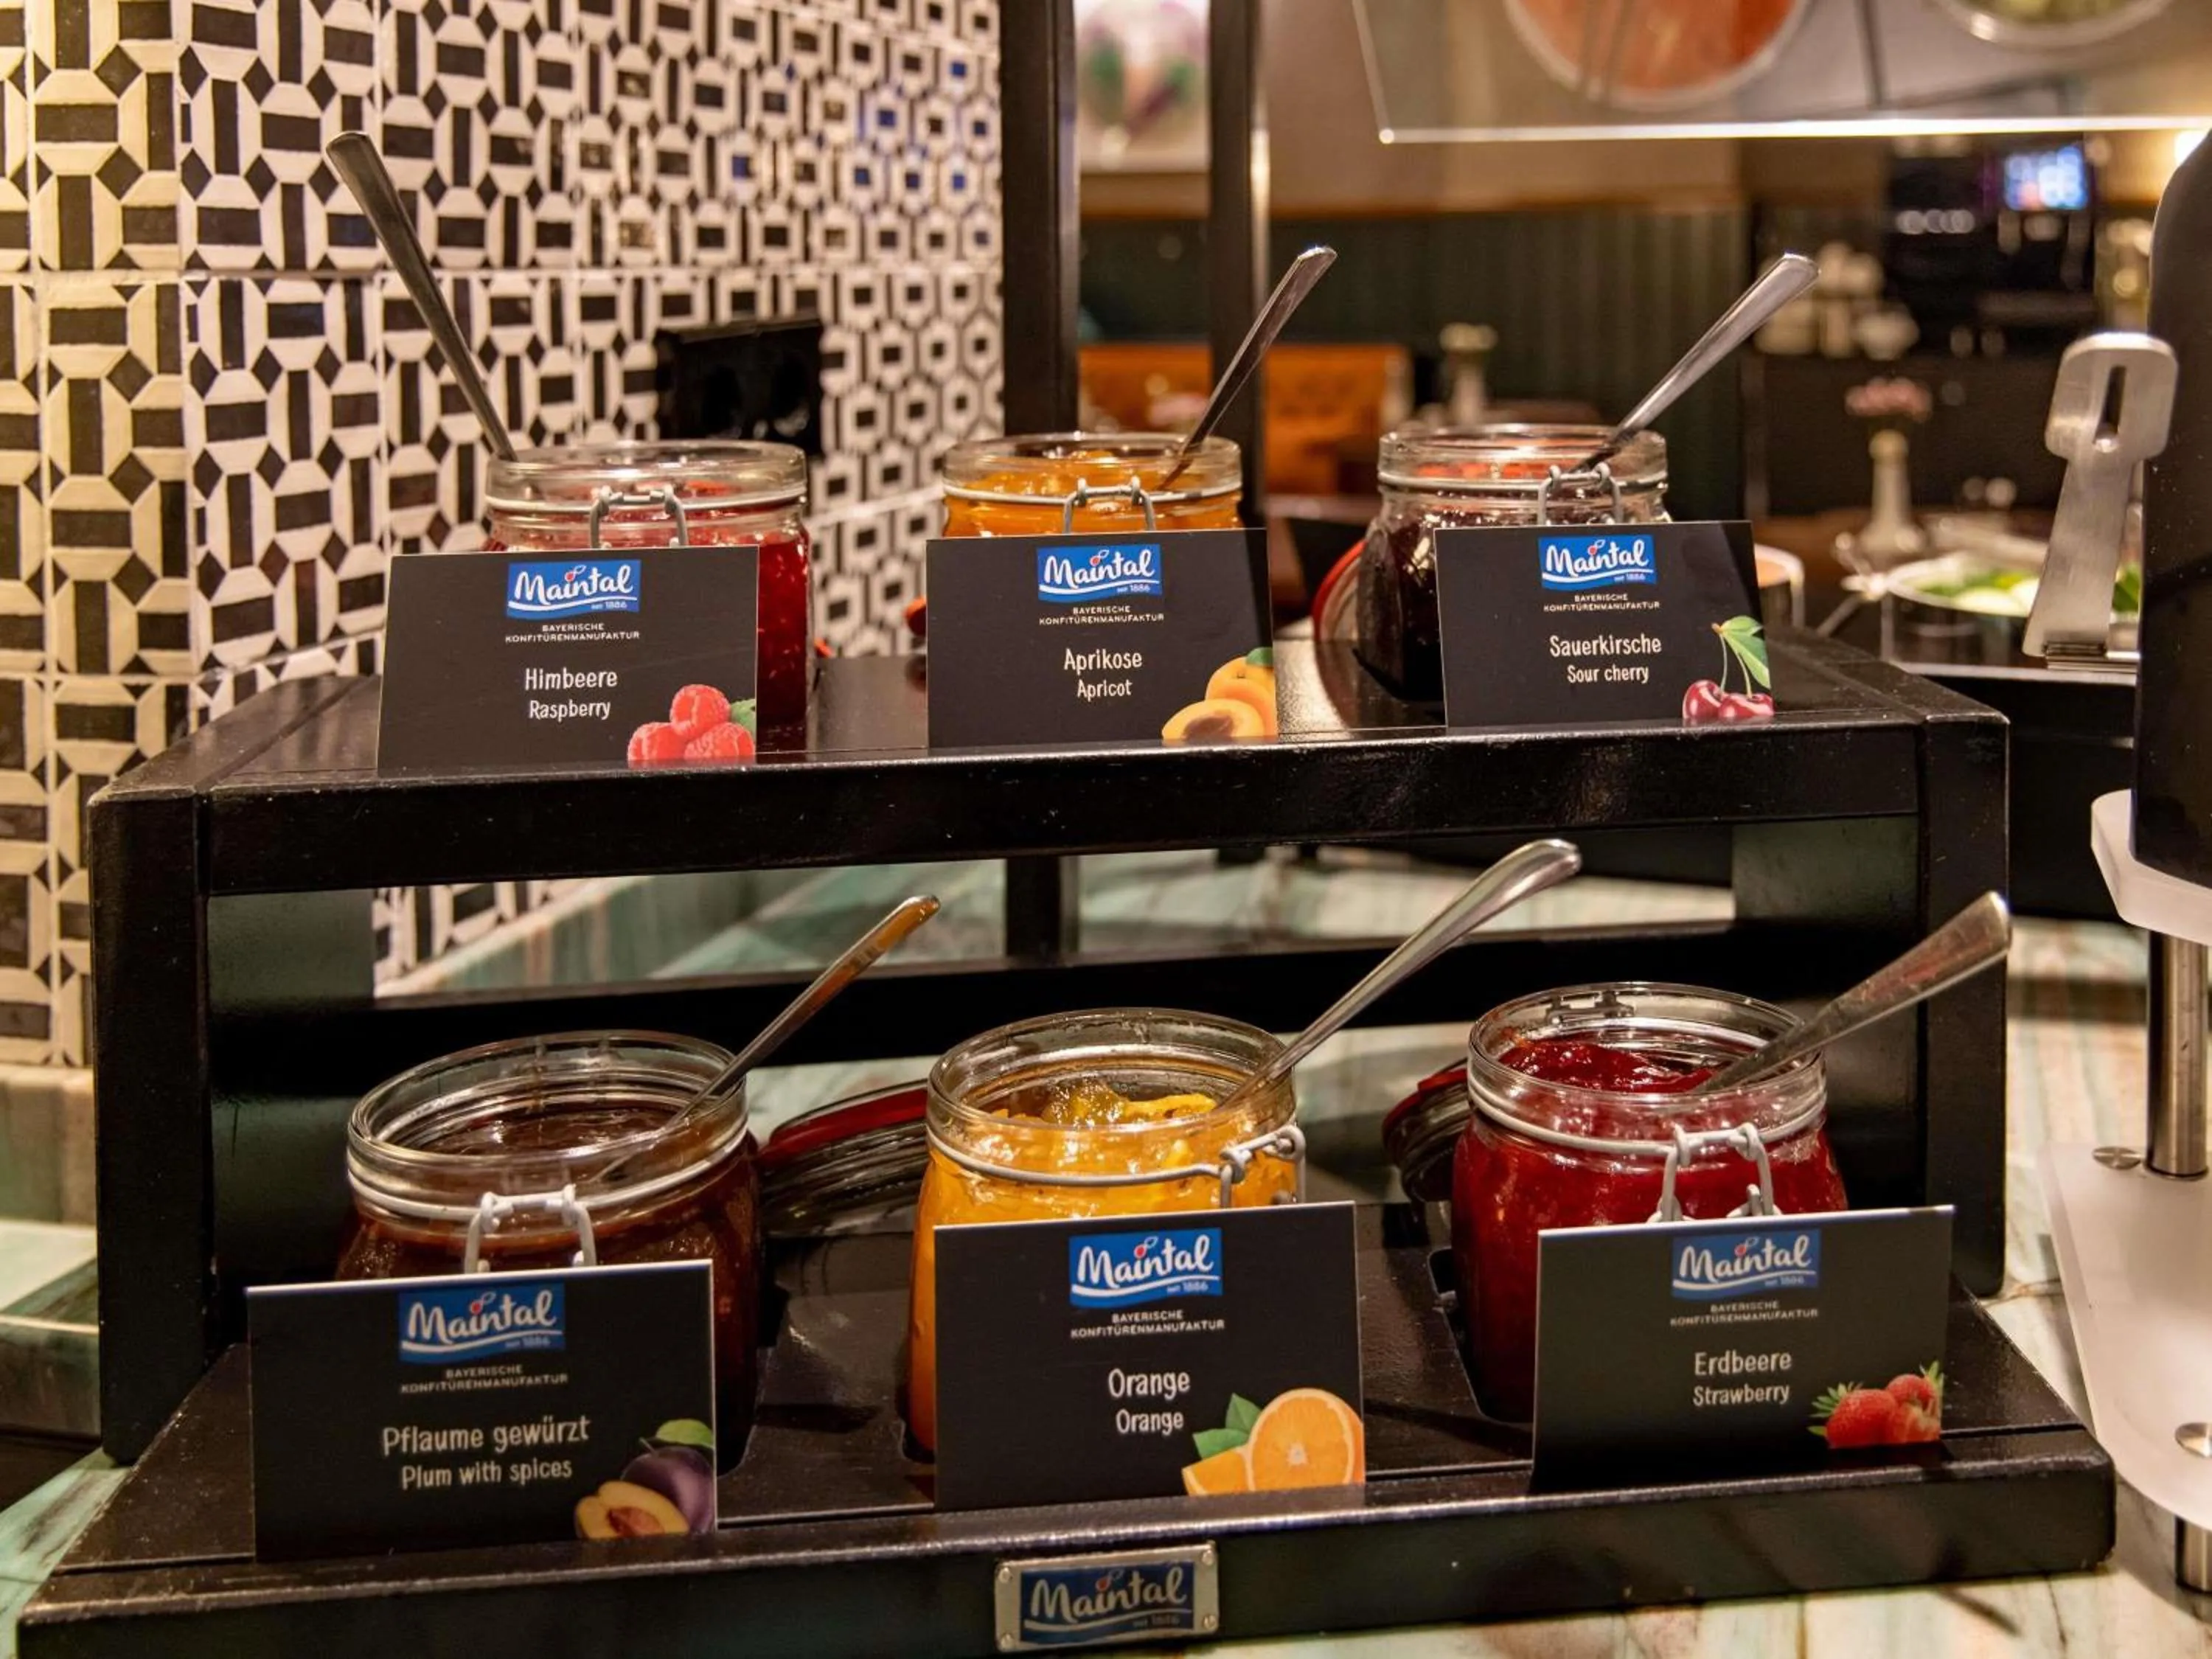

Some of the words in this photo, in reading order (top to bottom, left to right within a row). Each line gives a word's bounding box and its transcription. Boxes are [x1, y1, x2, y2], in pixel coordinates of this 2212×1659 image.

[1043, 549, 1155, 588] Maintal
[1545, 539, 1649, 577] Maintal
[513, 564, 634, 605] Maintal
[1544, 601, 1660, 612] KONFITÜRENMANUFAKTUR
[1574, 594, 1628, 602] BAYERISCHE
[1039, 613, 1164, 625] KONFITÜRENMANUFAKTUR
[1073, 605, 1130, 615] BAYERISCHE
[505, 631, 640, 643] KONFITÜRENMANUFAKTUR
[542, 623, 605, 632] BAYERISCHE
[1550, 633, 1662, 658] Sauerkirsche
[1064, 648, 1142, 674] Aprikose
[525, 667, 618, 691] Himbeere
[1567, 666, 1599, 684] Sour
[1604, 664, 1649, 684] cherry
[1077, 680, 1132, 701] Apricot
[529, 700, 611, 720] Raspberry
[1077, 1234, 1214, 1286] Maintal
[1680, 1234, 1811, 1283] Maintal
[408, 1290, 557, 1344] Maintal
[1112, 1310, 1183, 1324] BAYERISCHE
[1711, 1301, 1779, 1313] BAYERISCHE
[1071, 1319, 1225, 1338] KONFITÜRENMANUFAKTUR
[446, 1365, 523, 1379] BAYERISCHE
[1695, 1352, 1792, 1376] Erdbeere
[400, 1373, 568, 1394] KONFITÜRENMANUFAKTUR
[1108, 1368, 1190, 1400] Orange
[1693, 1384, 1790, 1406] Strawberry
[1116, 1408, 1184, 1434] Orange
[383, 1425, 484, 1456] Pflaume
[494, 1416, 591, 1453] gewürzt
[402, 1464, 452, 1489] Plum
[459, 1461, 501, 1484] with
[509, 1458, 572, 1485] spices
[1031, 1566, 1187, 1623] Maintal
